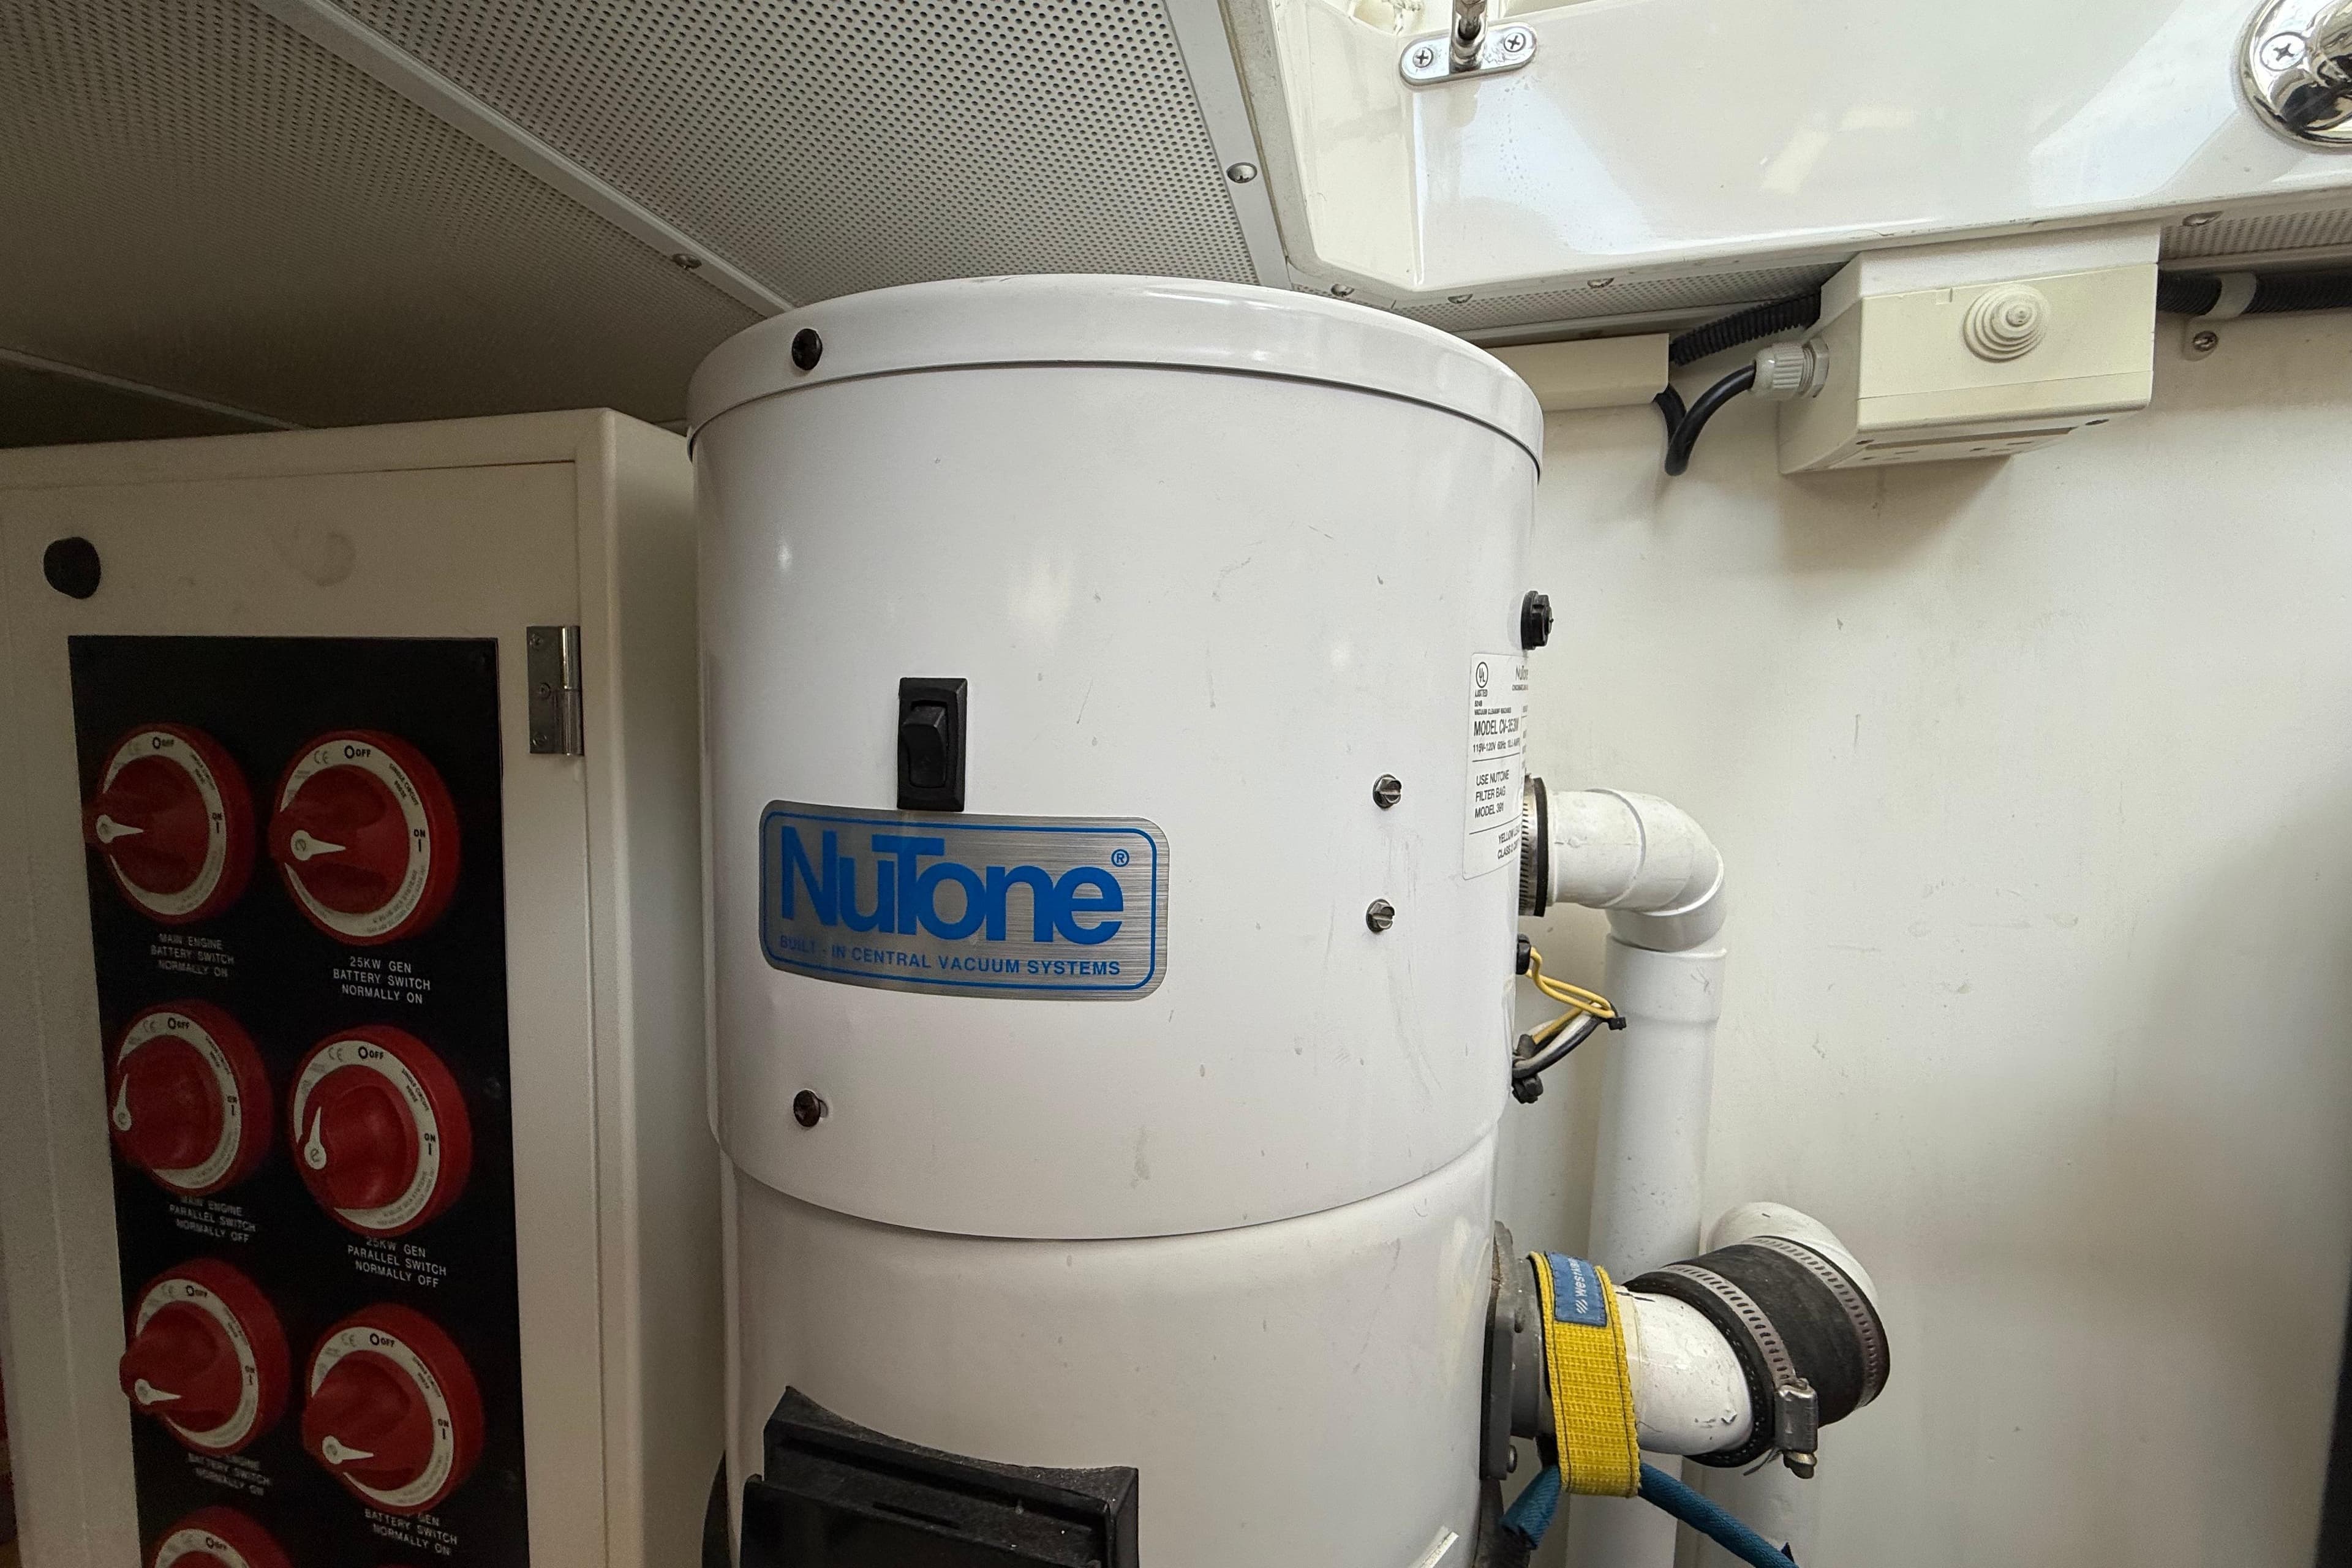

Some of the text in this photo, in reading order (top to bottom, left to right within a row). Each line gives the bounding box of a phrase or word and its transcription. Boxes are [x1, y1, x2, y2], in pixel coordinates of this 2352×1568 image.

[1474, 720, 1498, 736] MODEL
[1476, 769, 1509, 786] USE NUTONE
[1476, 786, 1506, 802] FILTER BAG
[1475, 804, 1495, 819] MODEL
[350, 956, 412, 974] 25KW GEN
[851, 946, 932, 968] CENTRAL
[938, 955, 1020, 973] VACUUM
[1027, 960, 1121, 976] SYSTEMS
[214, 966, 228, 978] ON
[333, 968, 431, 991] BATTERY SWITCH
[341, 984, 423, 1004] NORMALLY ON
[169, 1204, 216, 1223] PARALLEL
[230, 1231, 250, 1243] OFF
[404, 1243, 426, 1258] GEN
[347, 1245, 447, 1276] PARALLEL SWITCH
[355, 1260, 439, 1288] NORMALLY OFF
[364, 1508, 458, 1545] BATTERY SWITCH
[372, 1523, 451, 1556] NORMALLY ON
